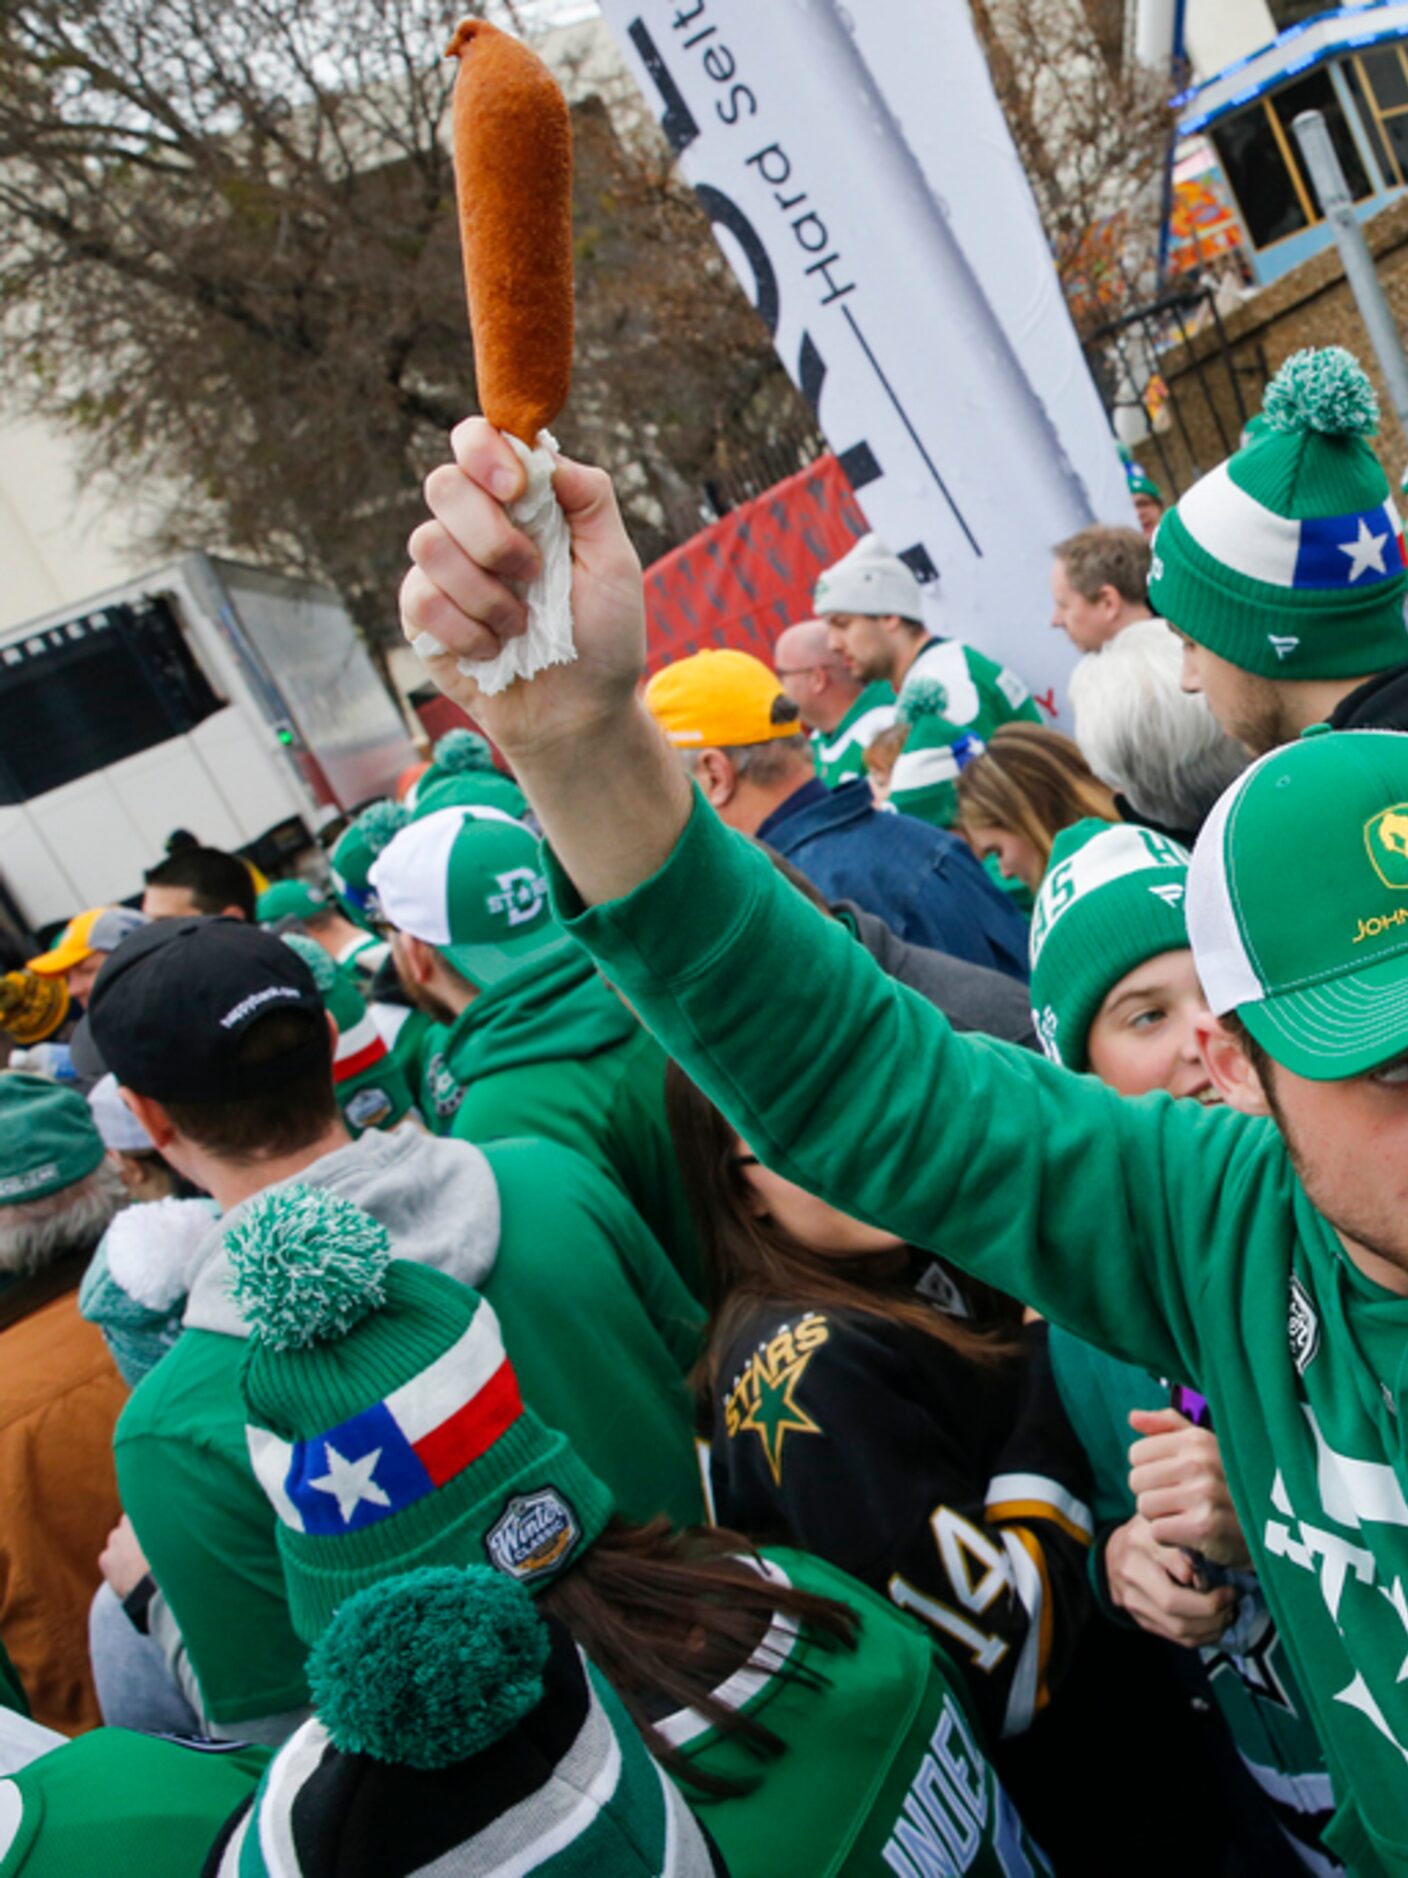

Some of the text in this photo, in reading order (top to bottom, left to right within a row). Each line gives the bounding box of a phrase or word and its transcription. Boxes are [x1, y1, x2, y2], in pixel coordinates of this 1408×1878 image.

[671, 0, 757, 125] Selt
[745, 142, 857, 306] Hard
[887, 1504, 1017, 1675] 14
